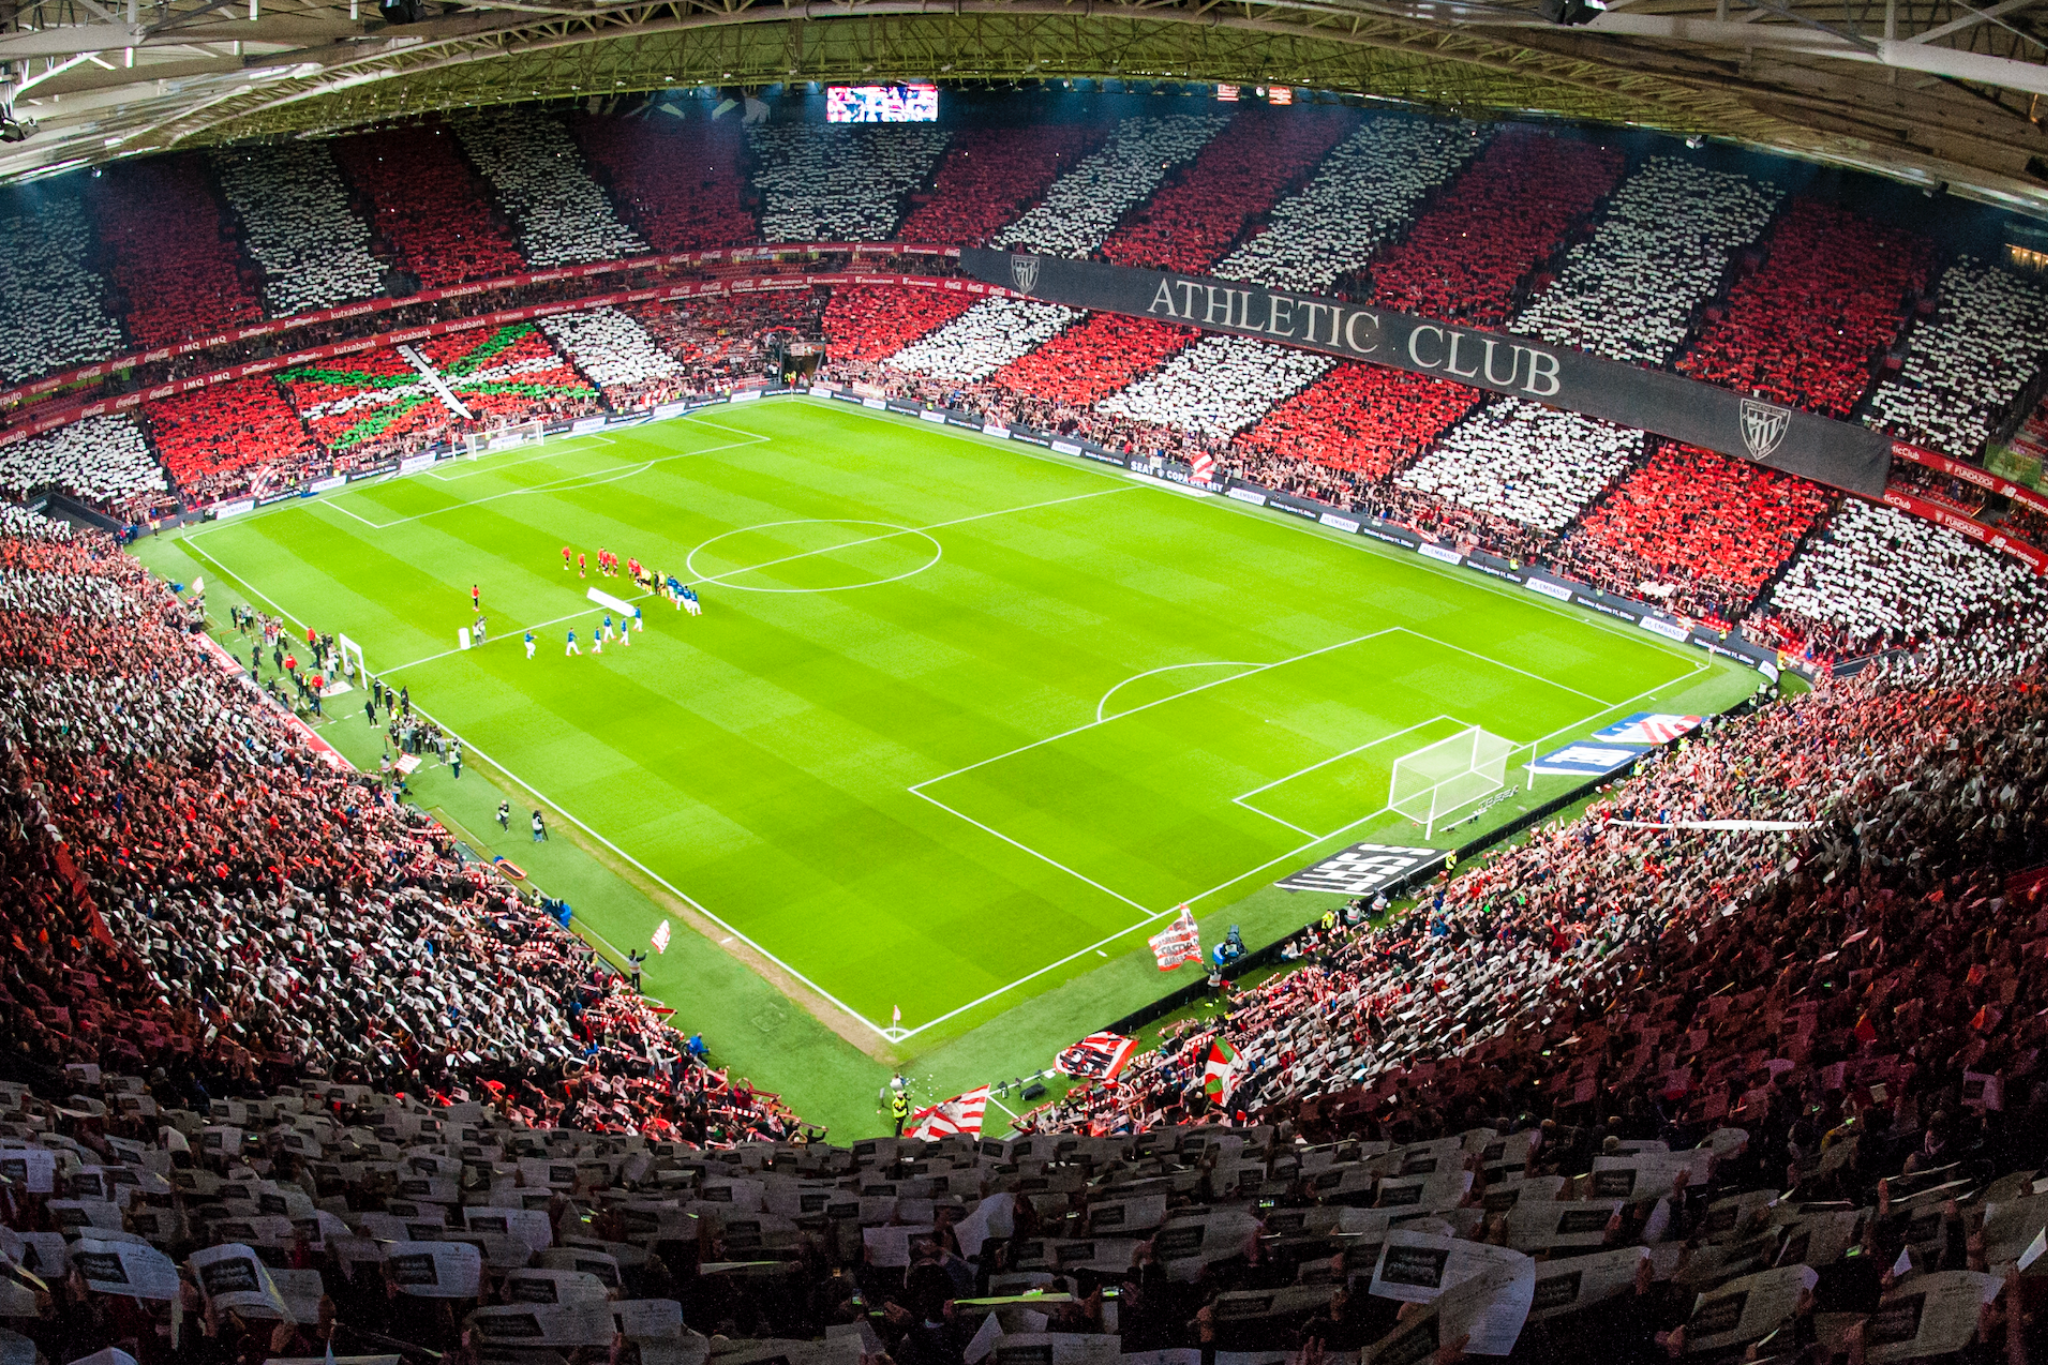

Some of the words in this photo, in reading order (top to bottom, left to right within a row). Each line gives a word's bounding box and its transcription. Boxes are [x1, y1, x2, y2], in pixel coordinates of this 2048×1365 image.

[670, 286, 691, 296] Coca-Cola
[700, 282, 722, 292] Coca-Cola
[731, 279, 754, 289] Coca-Cola
[967, 284, 984, 293] Coca-Cola
[441, 284, 482, 299] kutxabank
[989, 286, 1006, 297] Coca-Cola
[330, 304, 374, 320] kutxabank
[446, 318, 486, 333] kutxabank
[206, 336, 227, 347] IMQ
[390, 328, 432, 344] kutxabank
[1146, 276, 1381, 354] ATHLETIC
[1408, 324, 1562, 397] CLUB
[179, 341, 200, 353] IMQ
[334, 340, 376, 355] kutxabank
[144, 348, 170, 363] Coca-Cola
[112, 356, 137, 371] Coca-Cola
[77, 366, 102, 380] Coca-Cola
[210, 372, 230, 384] IMQ
[183, 378, 205, 390] IMQ
[150, 385, 174, 400] Coca-Cola
[116, 394, 140, 408] Coca-Cola
[81, 404, 106, 418] Coca-Cola
[1130, 460, 1155, 476] SEAT
[1166, 470, 1188, 484] COPA
[1207, 481, 1224, 492] REY
